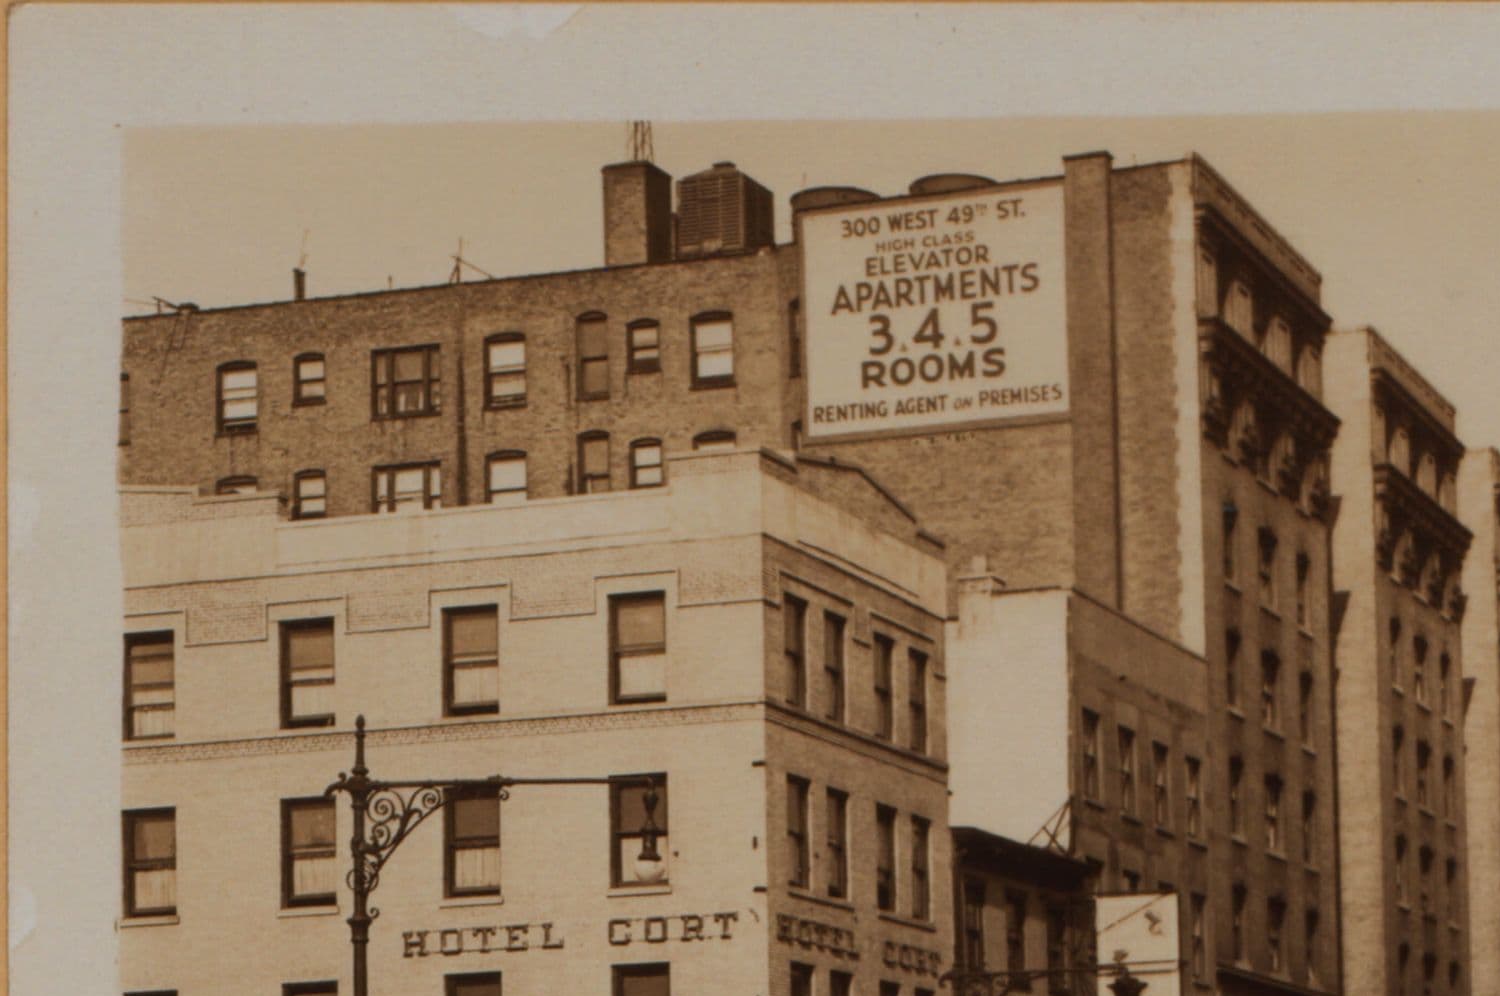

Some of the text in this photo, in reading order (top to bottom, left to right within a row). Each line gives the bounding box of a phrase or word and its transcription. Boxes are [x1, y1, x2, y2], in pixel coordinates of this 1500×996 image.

[841, 217, 881, 238] 300
[888, 209, 939, 233] WEST
[996, 199, 1026, 220] ST.
[865, 244, 990, 277] ELEVATOR
[875, 231, 975, 254] HIGH CLASS
[831, 263, 1040, 315] APARTMENTS
[861, 348, 1006, 389] ROOMS
[814, 401, 888, 424] RENTING
[895, 394, 947, 416] AGENT
[979, 384, 1063, 408] PREMISES
[401, 912, 738, 958] HOTEL CORT
[777, 914, 859, 960] HOTEL
